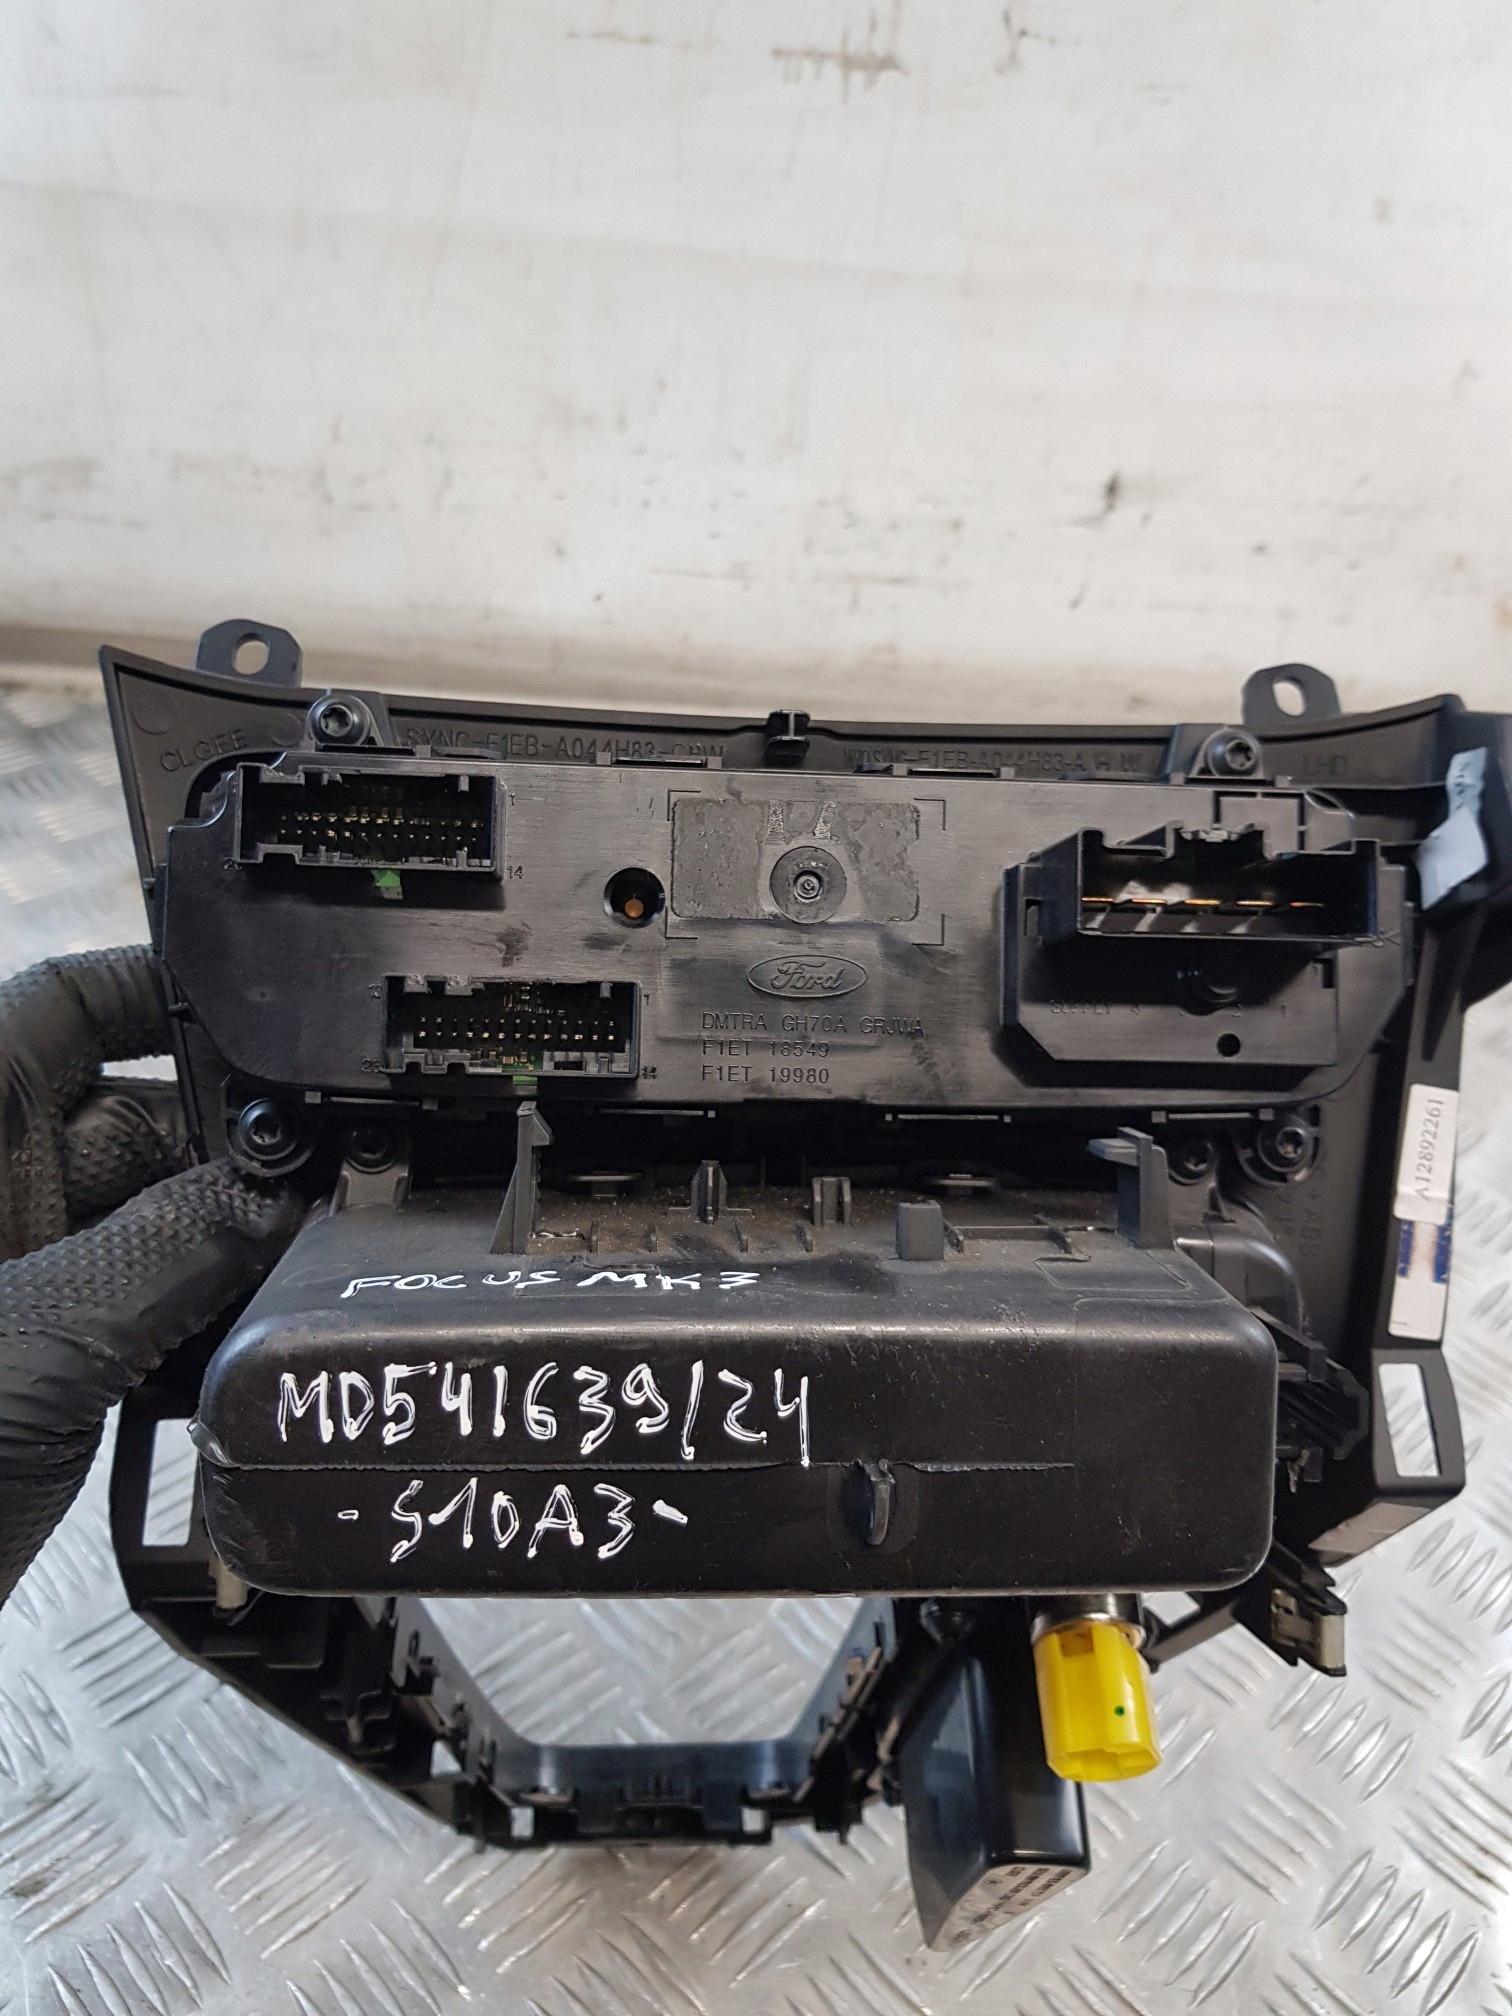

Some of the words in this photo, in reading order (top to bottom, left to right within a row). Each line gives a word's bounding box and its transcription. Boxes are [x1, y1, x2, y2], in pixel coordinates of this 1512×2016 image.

[770, 961, 844, 990] Ford
[702, 1012, 768, 1031] DMTRA
[781, 1014, 847, 1034] GH70A
[702, 1038, 753, 1056] F1ET
[768, 1040, 829, 1058] 18549
[702, 1065, 753, 1082] F1ET
[768, 1066, 829, 1084] 19980
[1414, 1098, 1444, 1202] A12892261
[341, 1270, 561, 1299] FOCUS
[277, 1360, 811, 1468] MD541639/24
